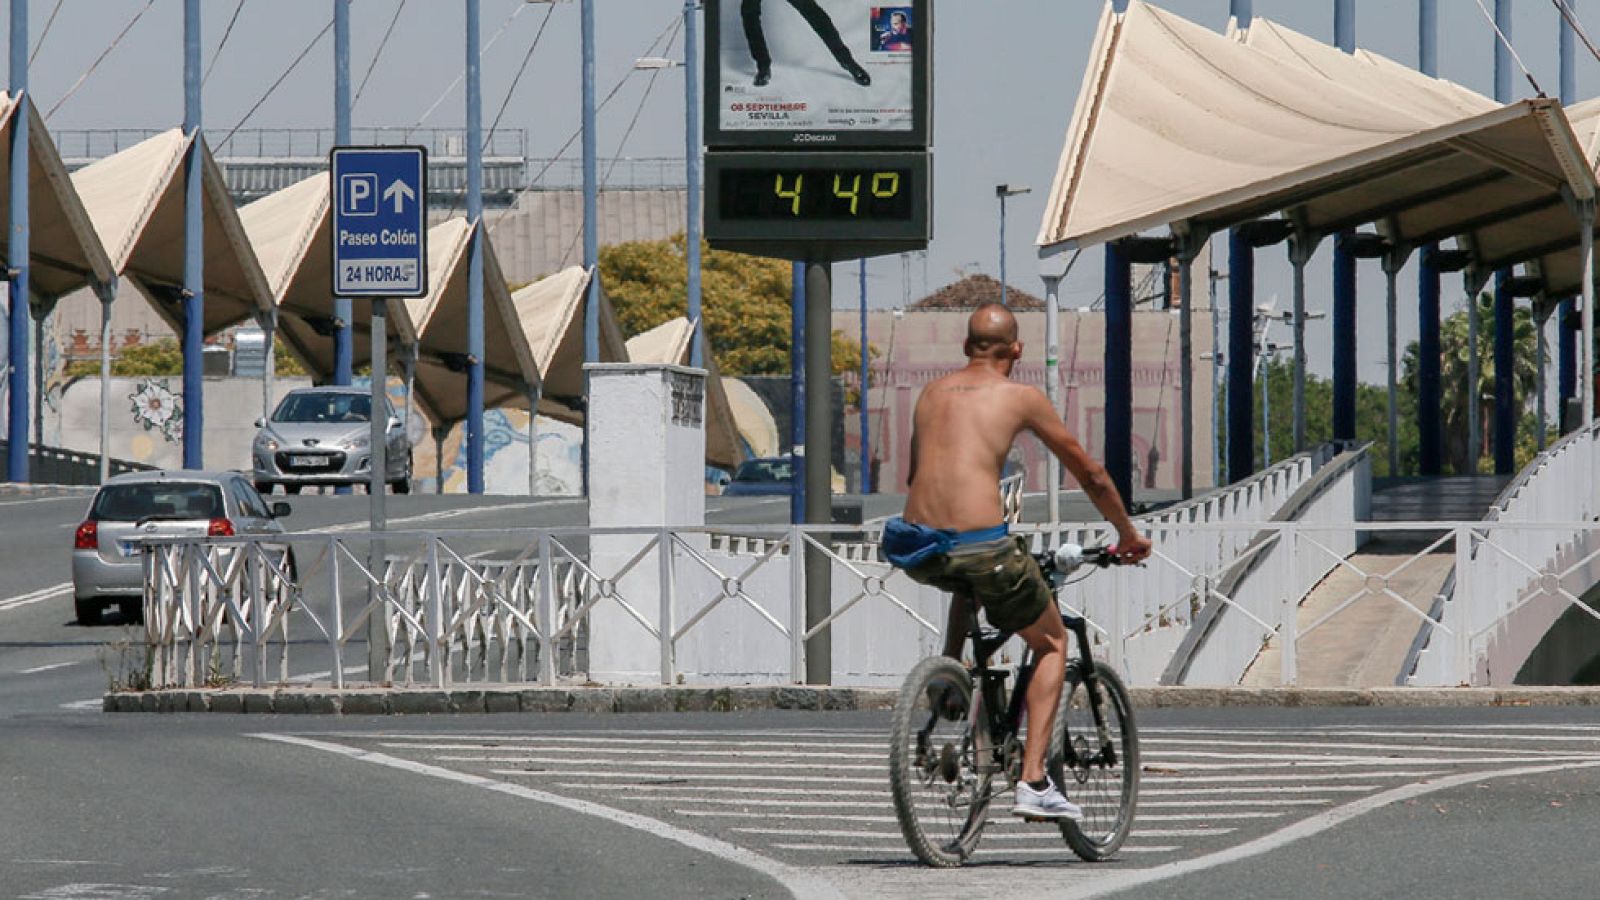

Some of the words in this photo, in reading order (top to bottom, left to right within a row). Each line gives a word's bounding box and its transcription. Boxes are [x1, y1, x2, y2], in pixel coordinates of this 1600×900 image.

[731, 102, 743, 111] 08
[745, 102, 807, 111] SEPTIEMBRE
[793, 133, 836, 142] JCDecaux
[350, 179, 370, 210] P
[340, 229, 377, 246] Paseo
[380, 228, 417, 246] Colón
[346, 265, 362, 282] 24
